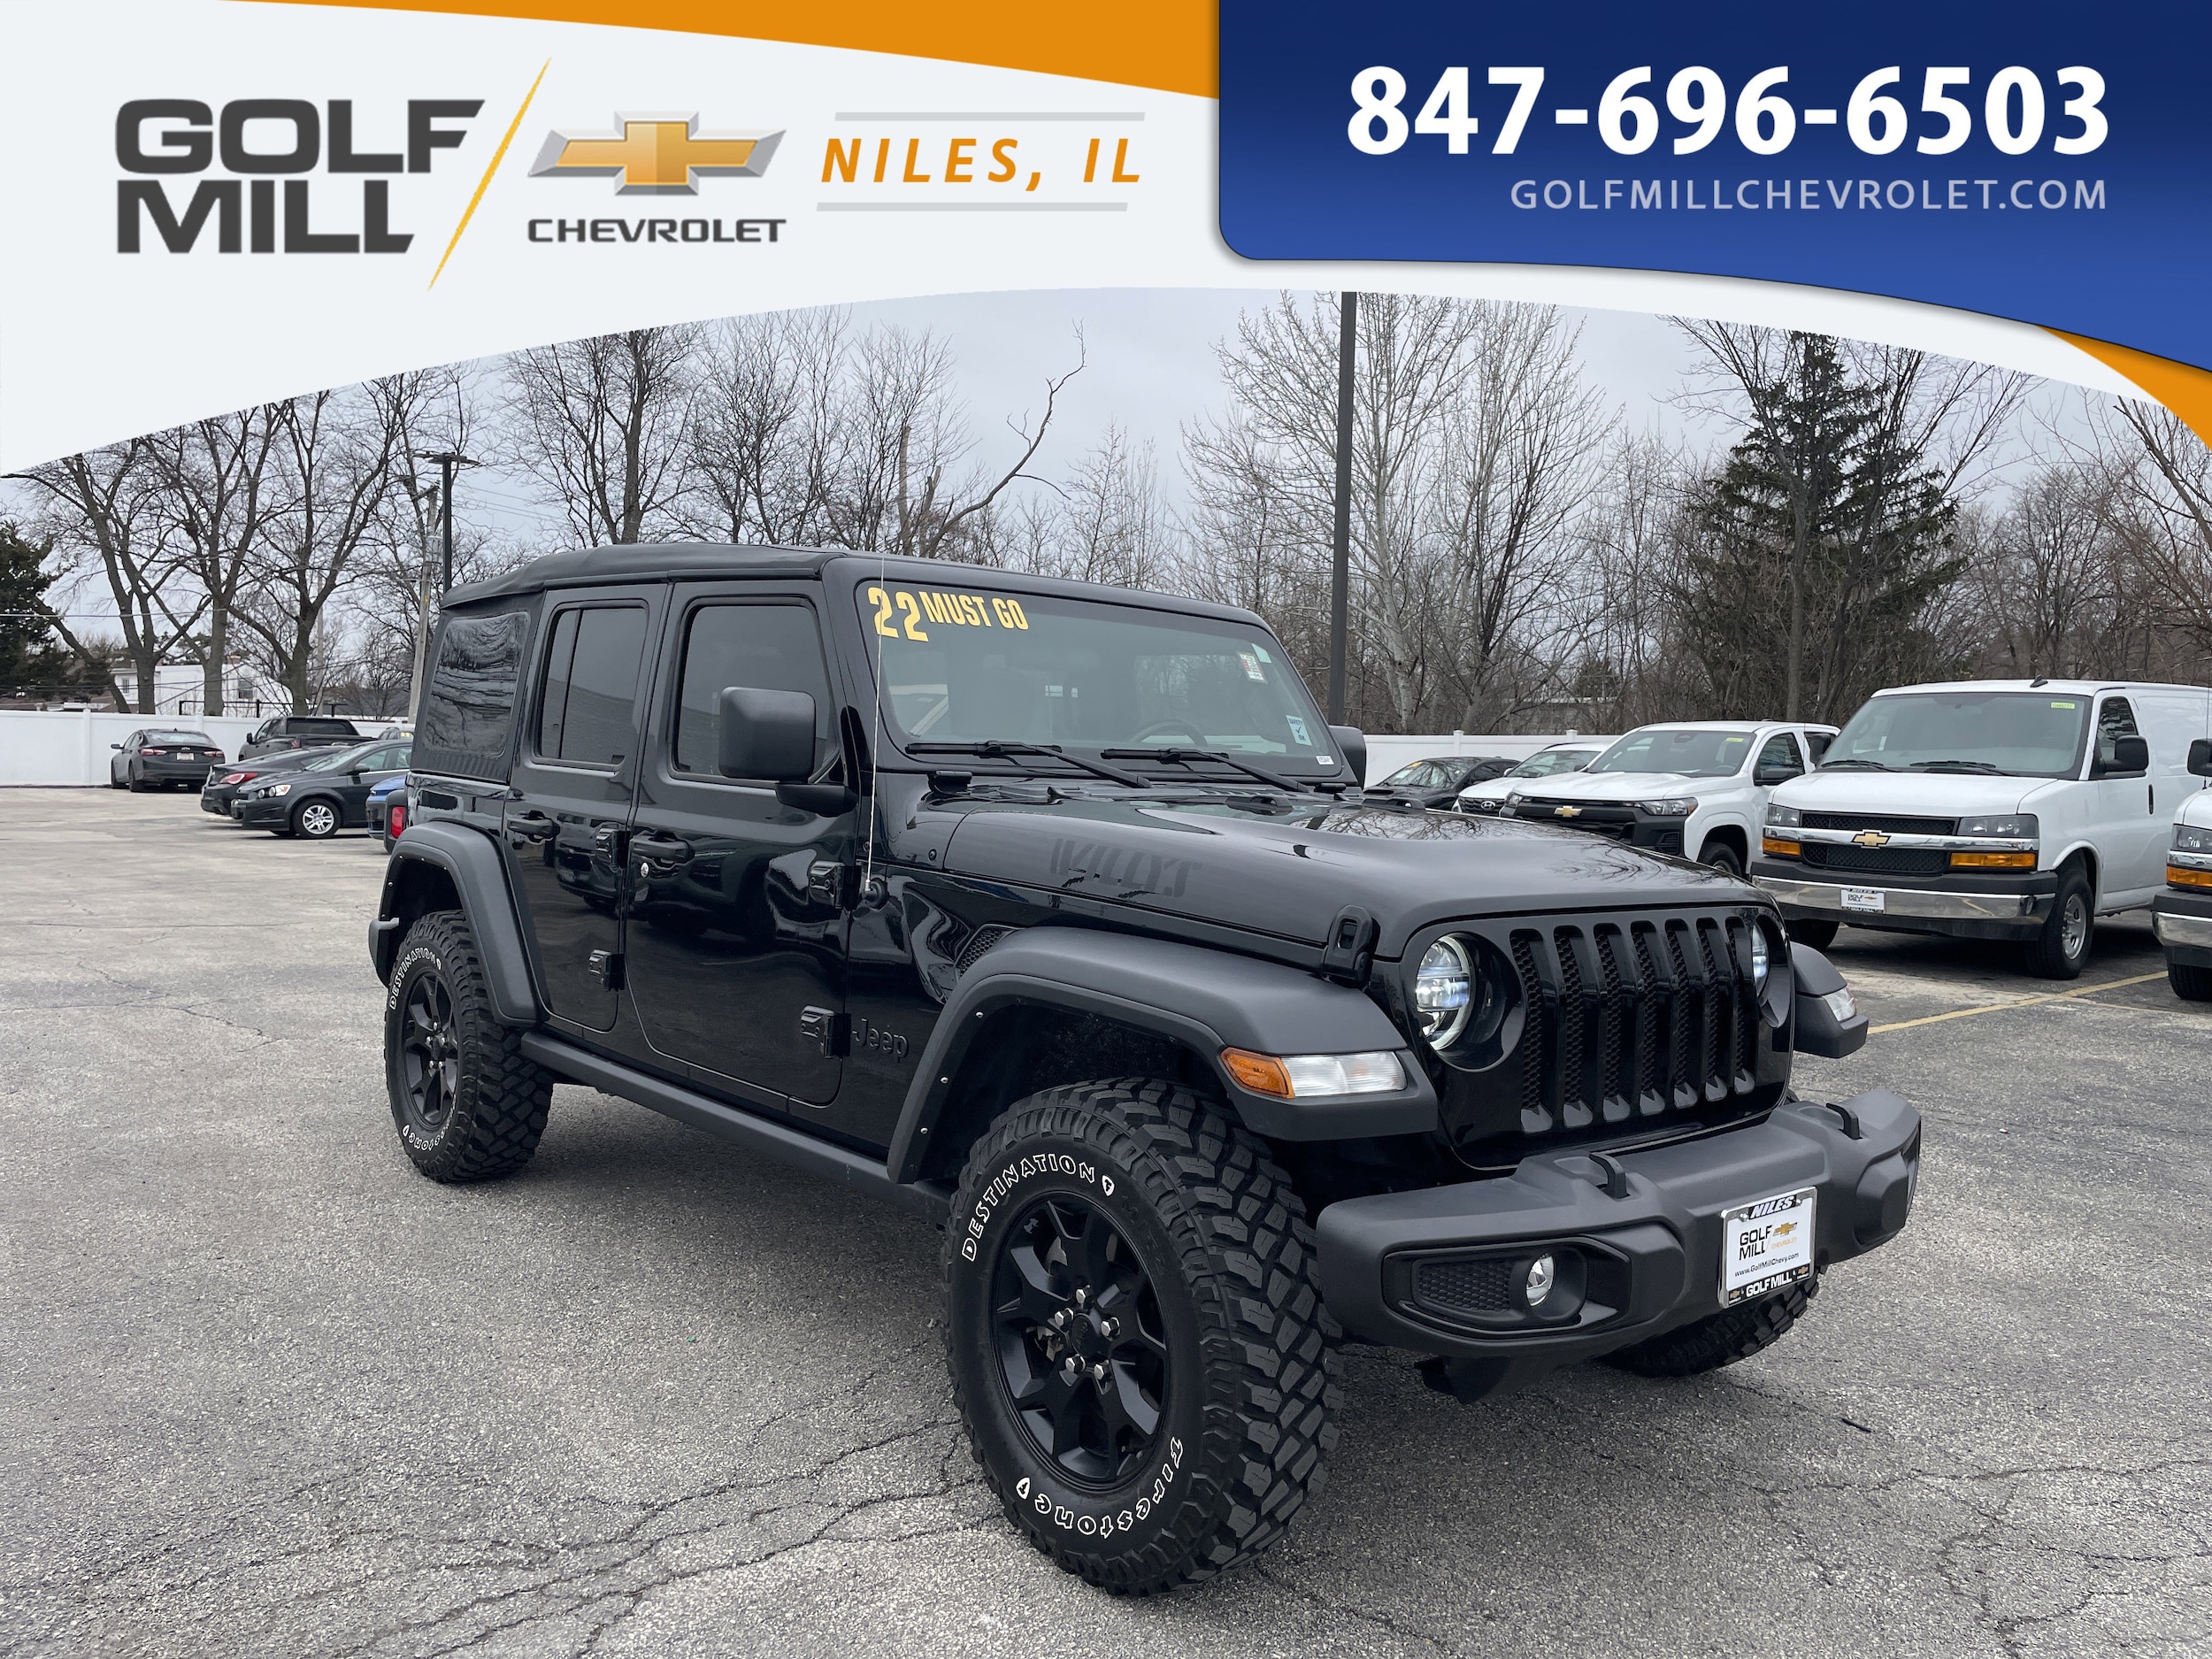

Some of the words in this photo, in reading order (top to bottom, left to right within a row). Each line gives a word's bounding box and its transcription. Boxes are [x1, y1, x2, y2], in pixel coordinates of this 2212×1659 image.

[867, 587, 929, 642] 22
[918, 590, 992, 627] MUST
[991, 596, 1029, 630] GO
[389, 947, 436, 1010] DESTINATION
[851, 1018, 910, 1064] Jeep
[961, 1153, 1095, 1263] DESTINATION
[1750, 1195, 1795, 1219] NILES
[1739, 1240, 1766, 1261] MILL
[1740, 1225, 1773, 1247] GOLF
[1746, 1278, 1770, 1298] GOLF
[1770, 1271, 1793, 1289] MILL
